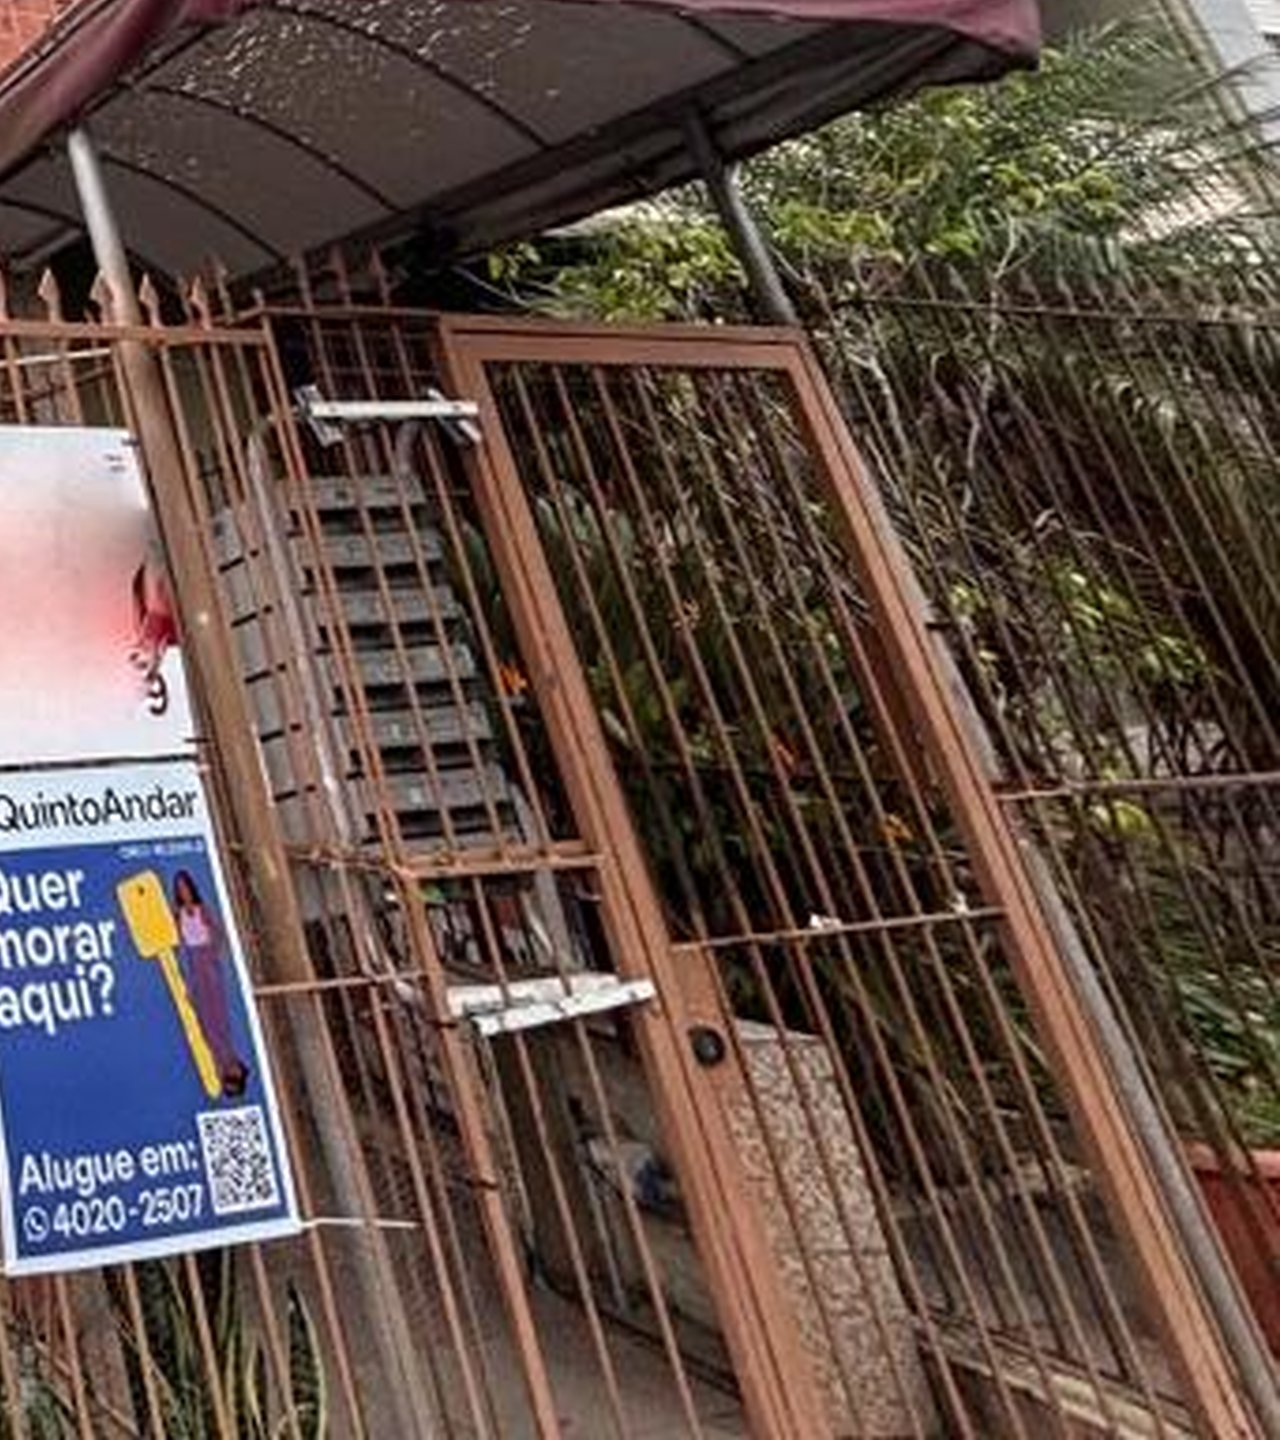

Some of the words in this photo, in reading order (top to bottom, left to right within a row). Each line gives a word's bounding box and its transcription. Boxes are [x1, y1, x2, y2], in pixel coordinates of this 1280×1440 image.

[19, 1148, 136, 1197] Alugue
[140, 1139, 201, 1177] em:
[52, 1183, 204, 1239] 4020-2507
